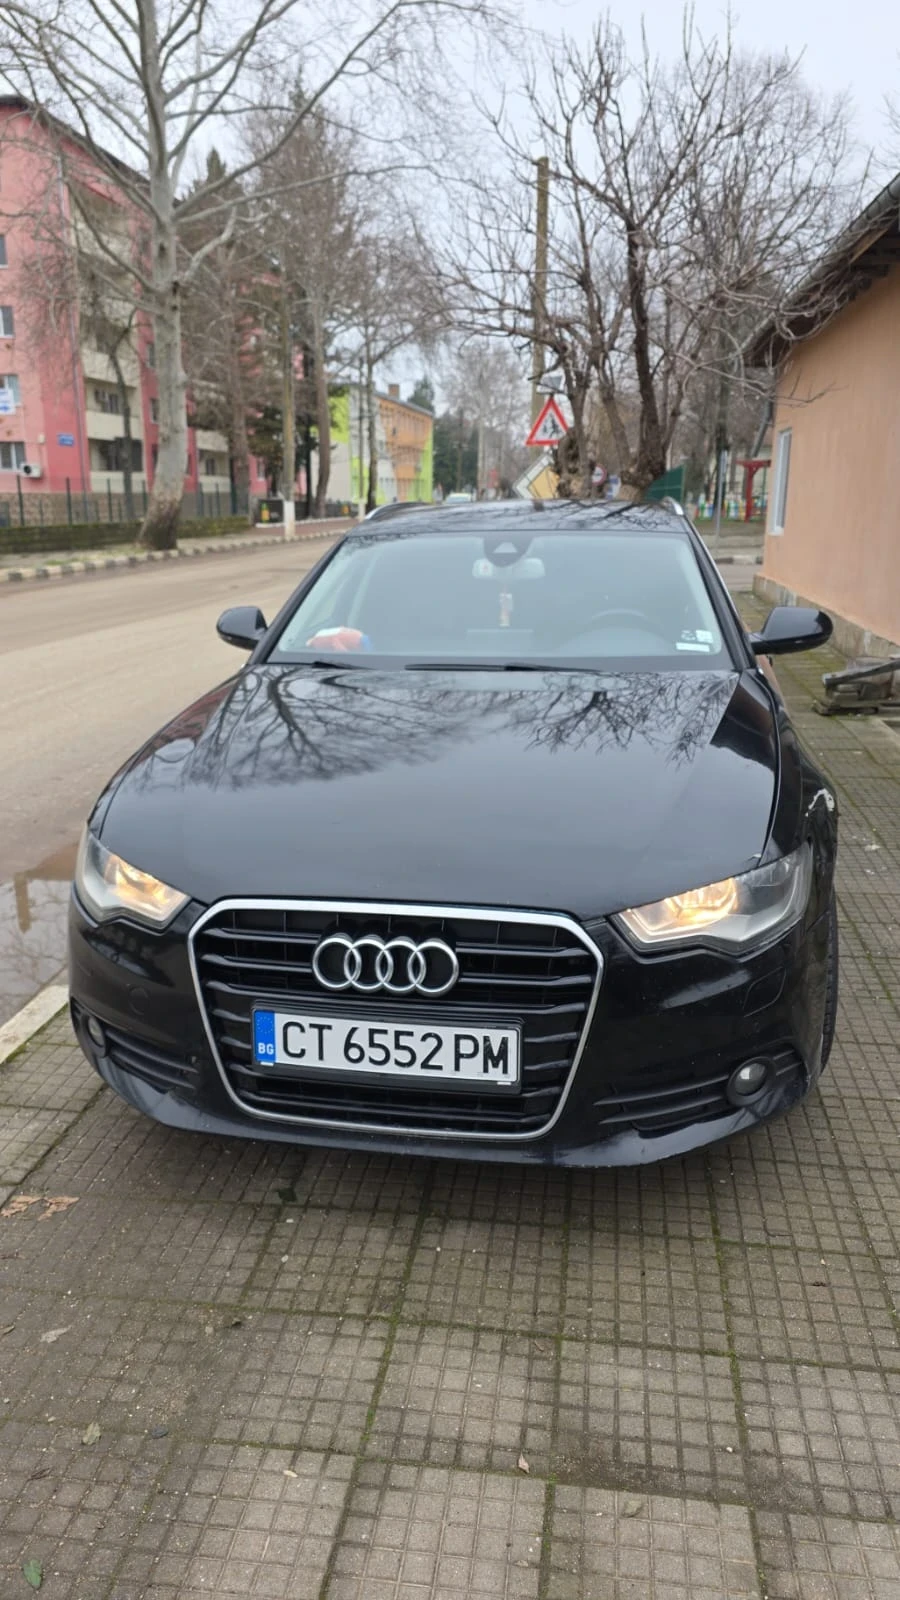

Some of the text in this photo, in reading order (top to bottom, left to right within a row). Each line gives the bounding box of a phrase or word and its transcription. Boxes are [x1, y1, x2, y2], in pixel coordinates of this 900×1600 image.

[258, 1043, 274, 1055] BG
[282, 1021, 508, 1074] CT 6552 PM
